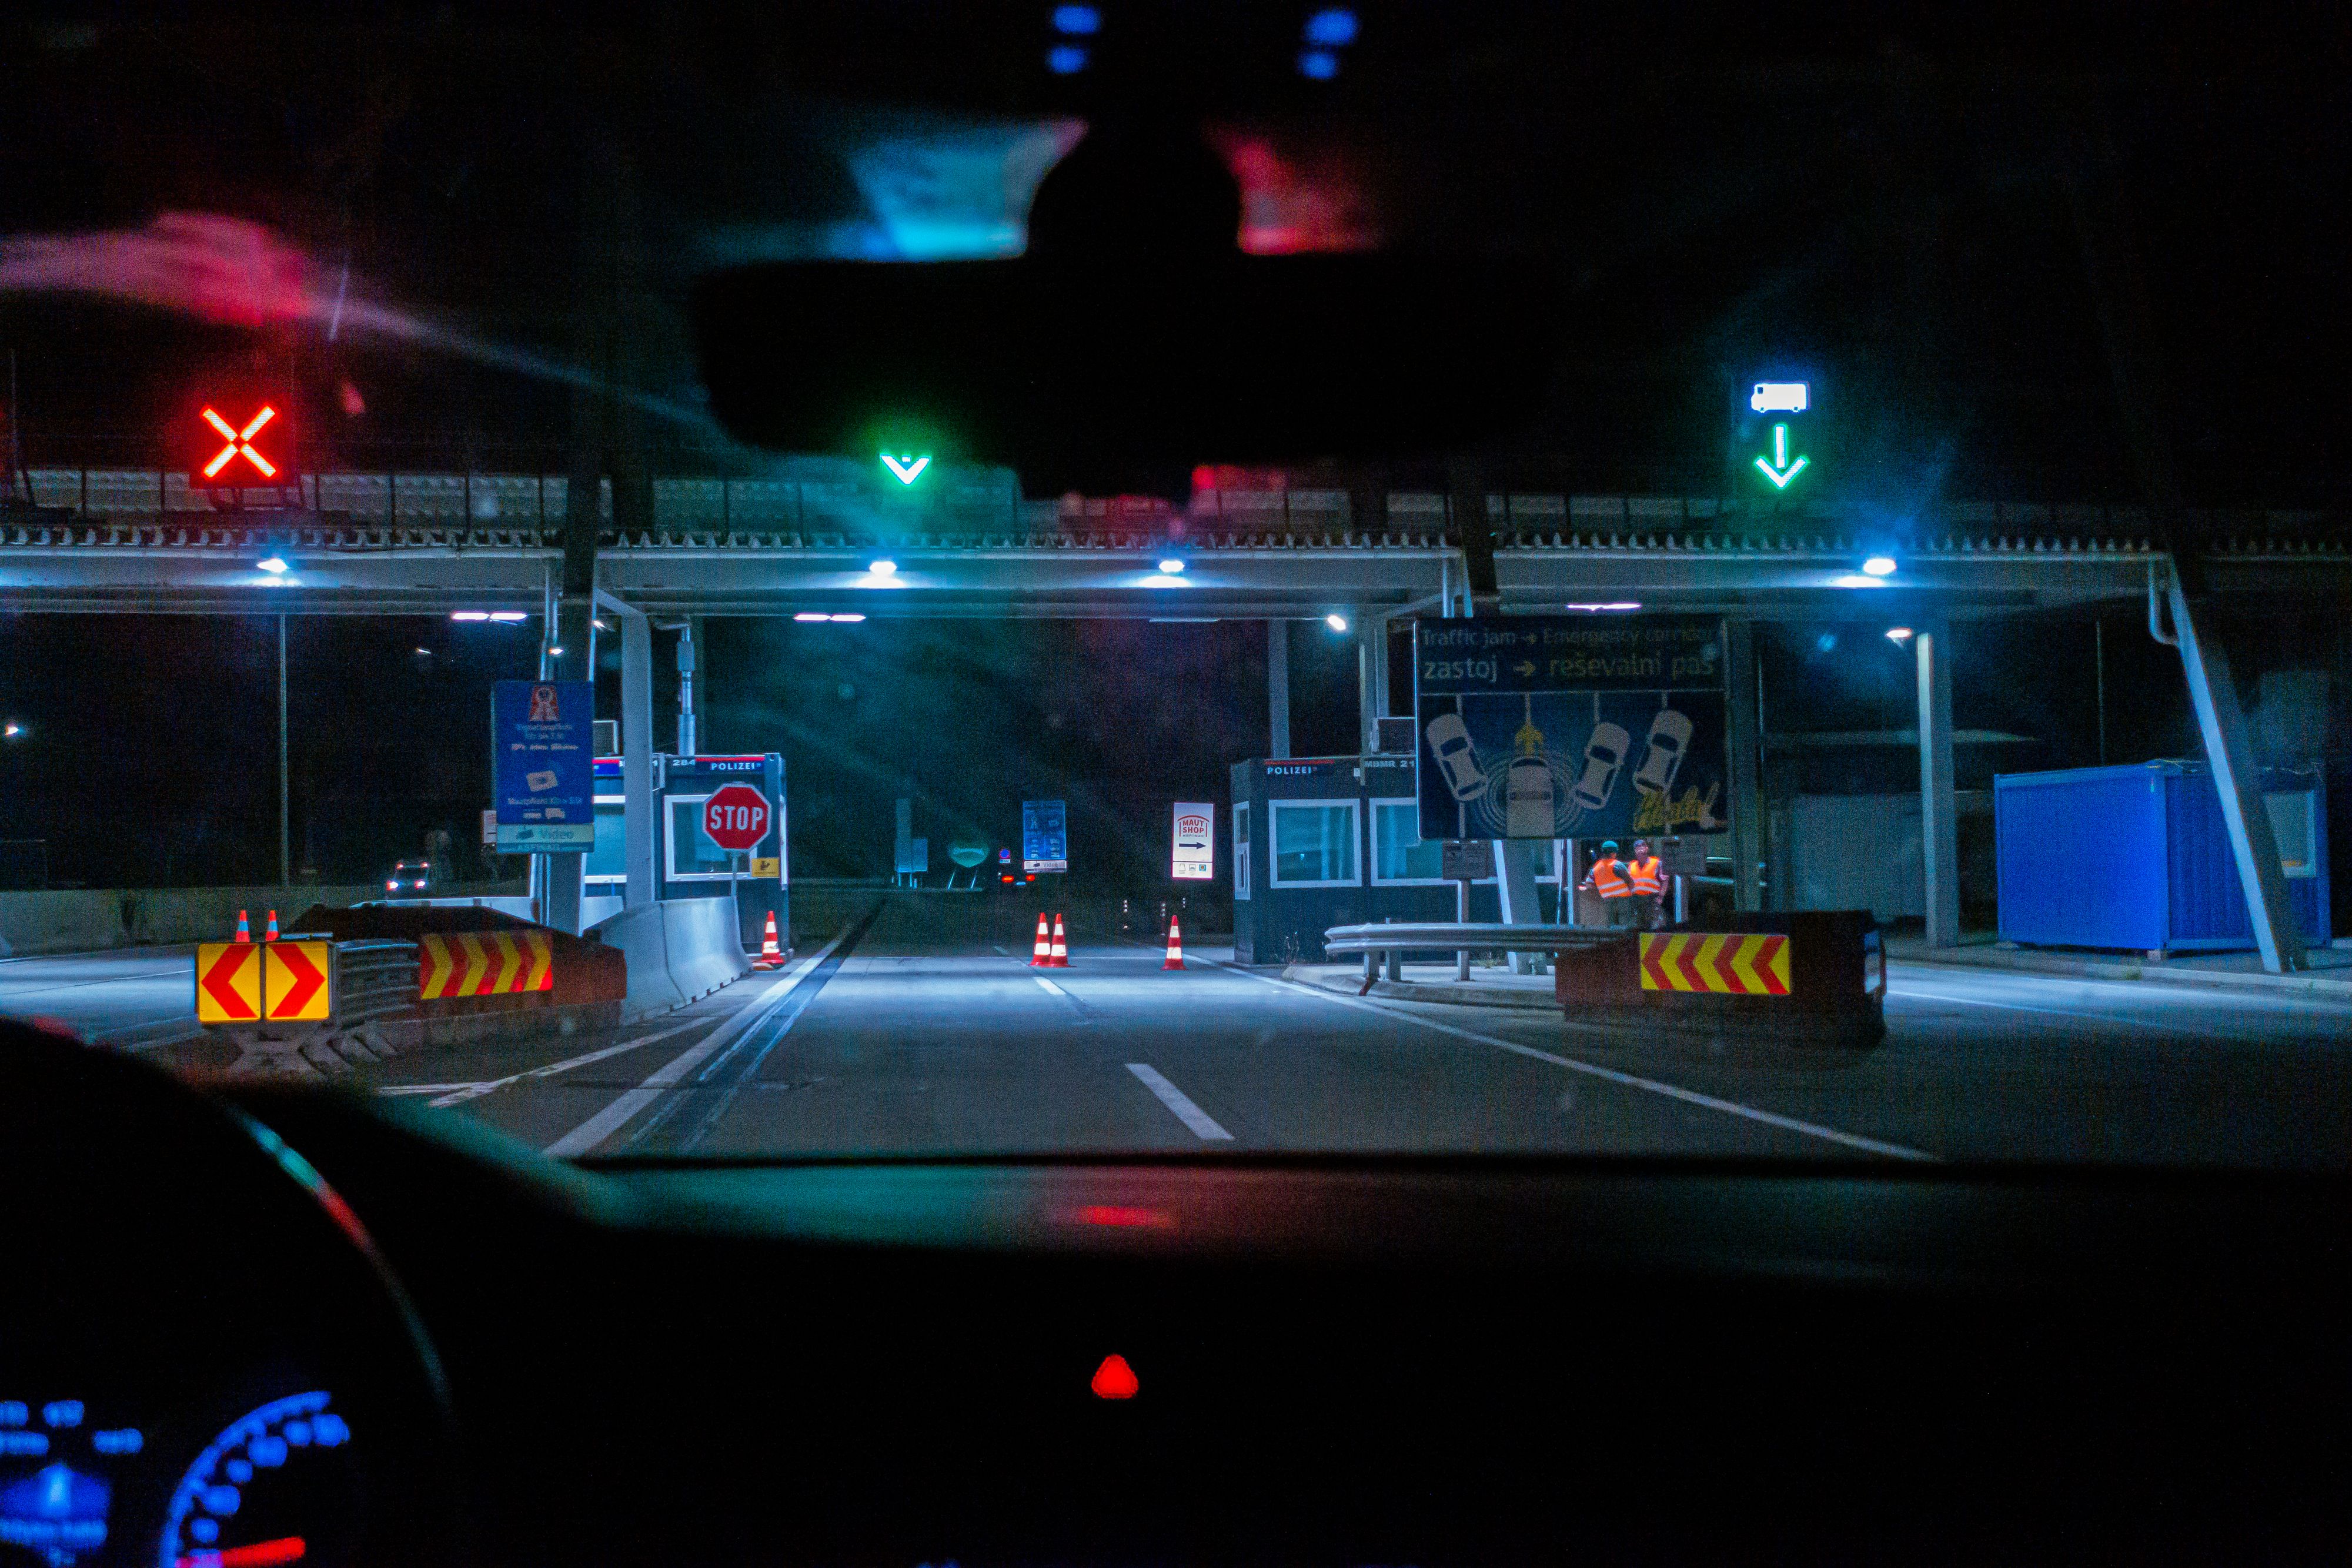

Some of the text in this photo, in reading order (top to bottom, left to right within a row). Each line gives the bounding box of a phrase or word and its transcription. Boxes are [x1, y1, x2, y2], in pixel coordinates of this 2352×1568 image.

[1422, 628, 1477, 646] Traffic
[1482, 627, 1518, 649] jam
[1424, 651, 1714, 683] zastoj reševalni pas
[711, 762, 755, 770] POLIZEI
[1267, 766, 1311, 775] POLIZEI
[710, 805, 764, 831] STOP
[1182, 819, 1204, 827] MAUT
[540, 828, 574, 840] Video
